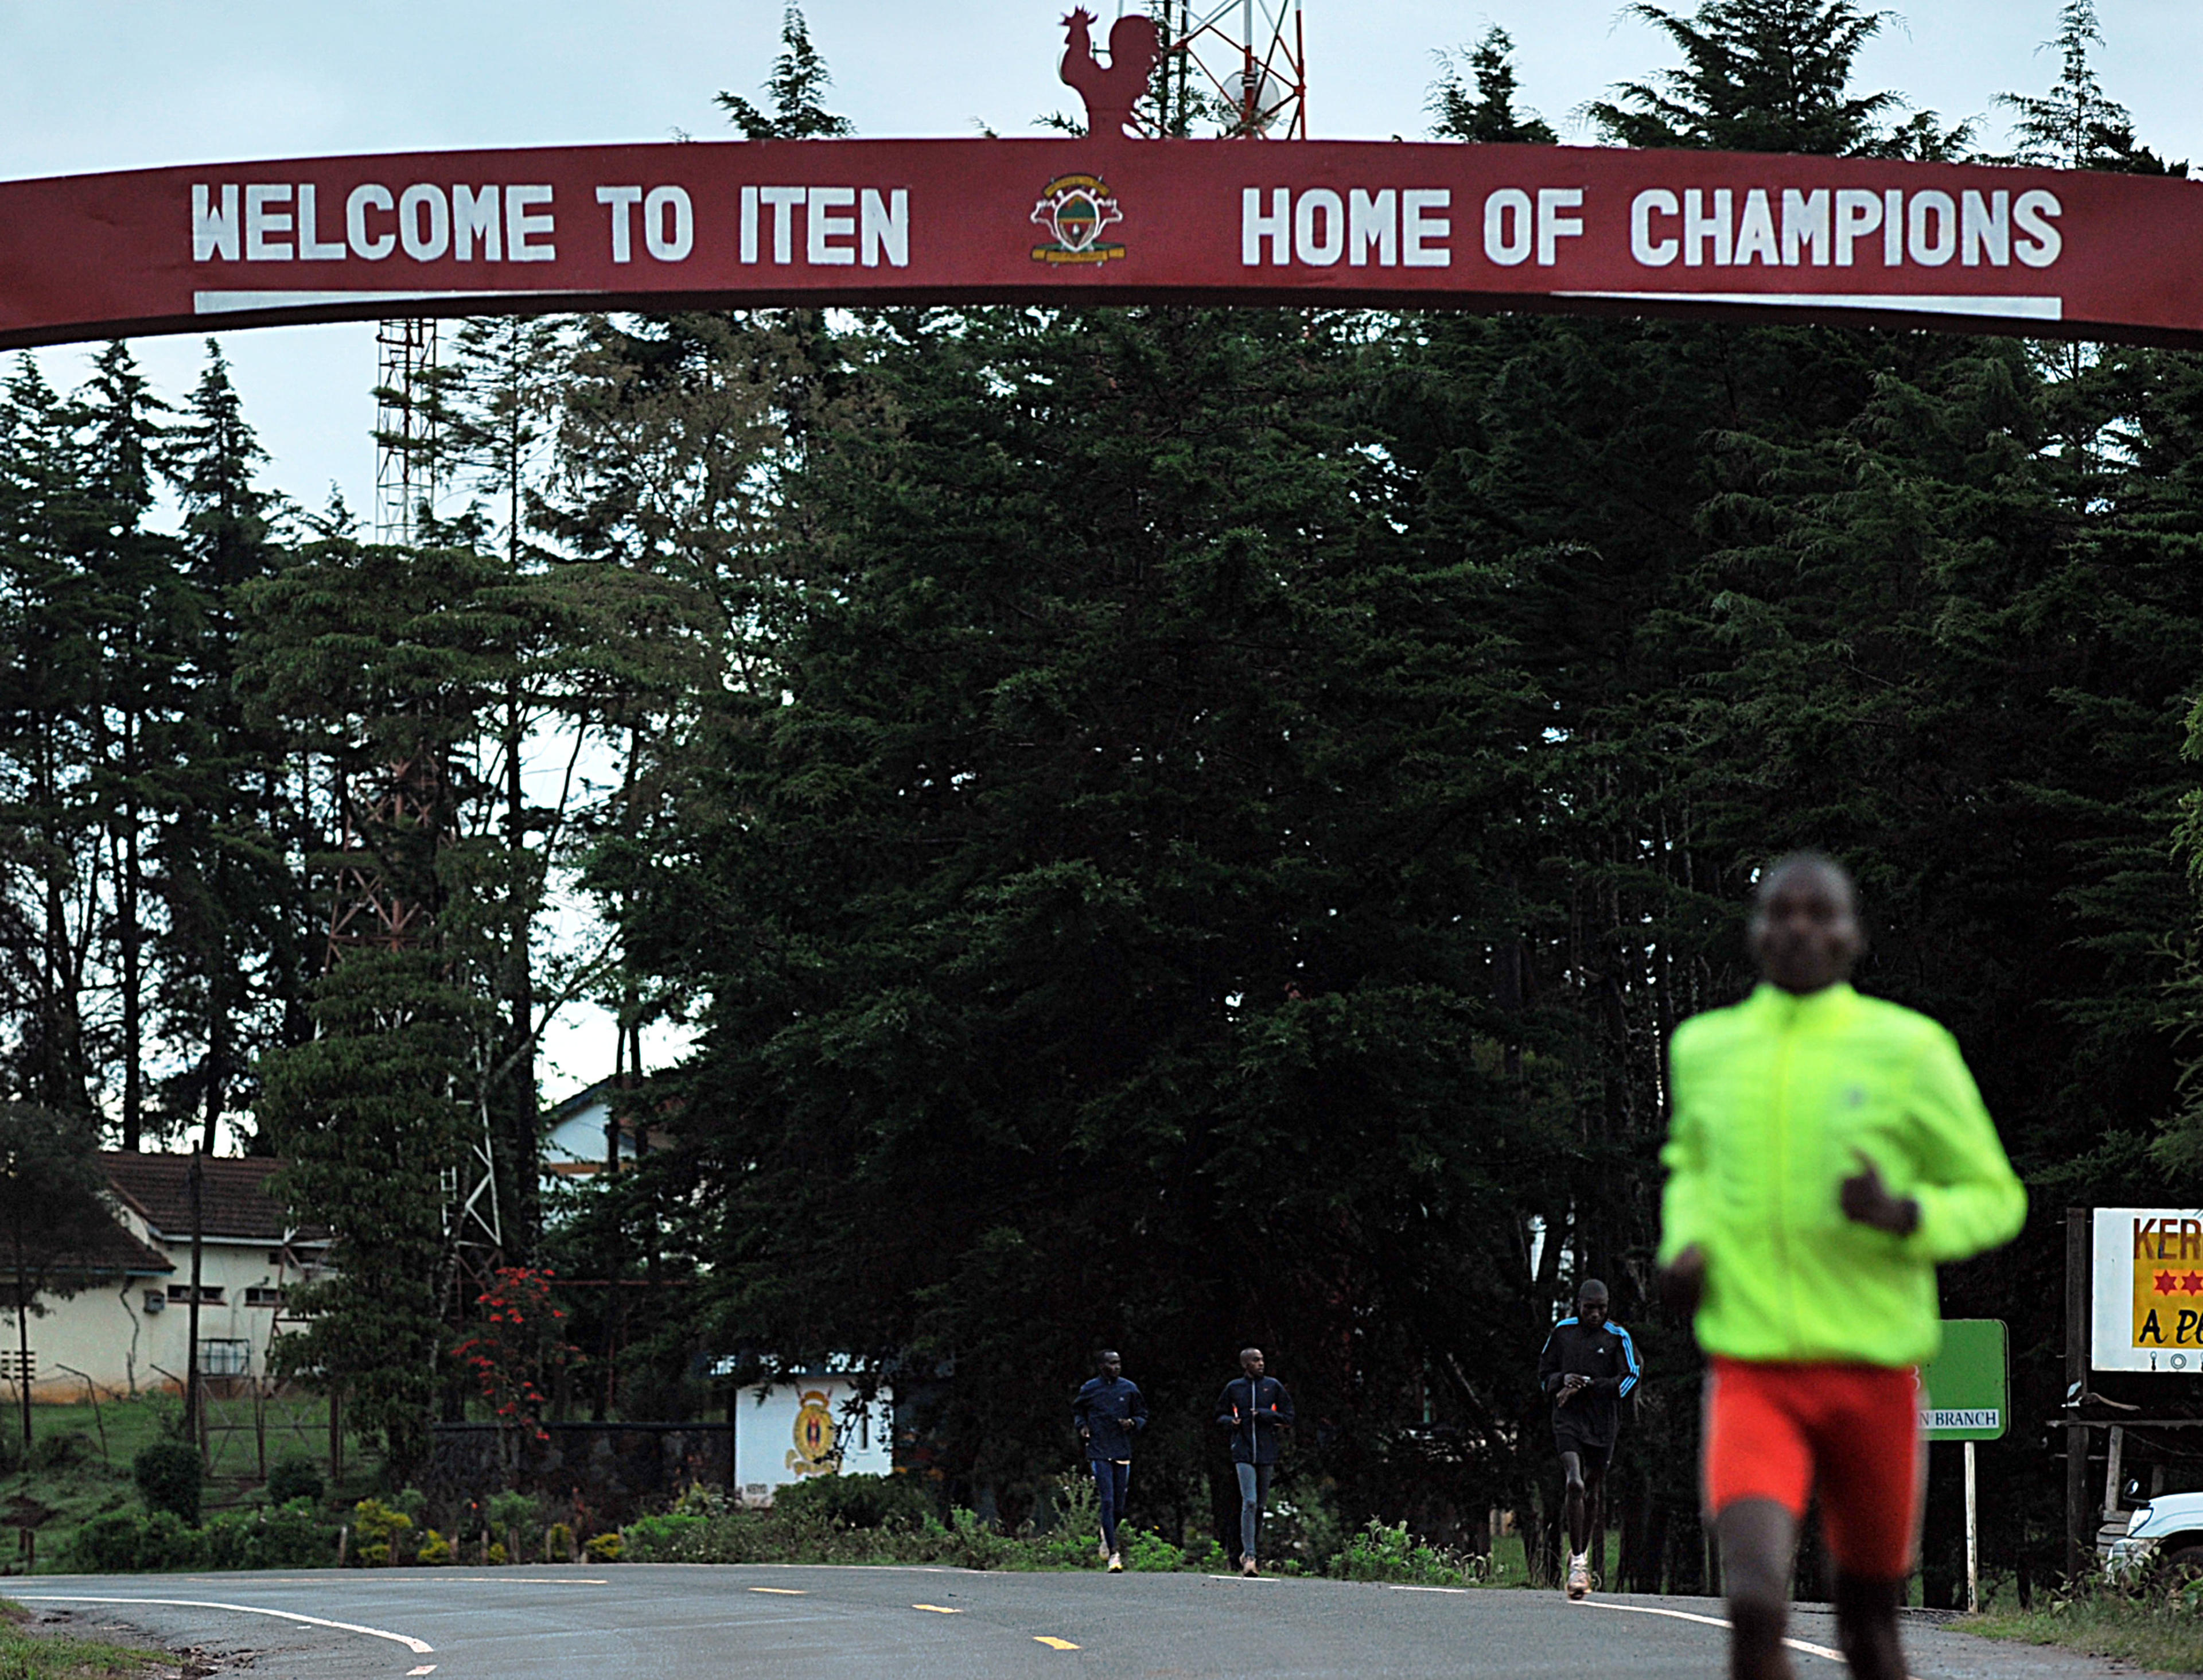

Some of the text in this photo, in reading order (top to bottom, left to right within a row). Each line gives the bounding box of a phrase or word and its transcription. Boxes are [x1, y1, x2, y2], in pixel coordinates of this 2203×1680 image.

[192, 184, 909, 267] WELCOME TO ITEN
[1242, 188, 2062, 267] HOME OF CHAMPIONS
[2139, 1309, 2169, 1344] A
[1936, 1411, 1996, 1426] BRANCH
